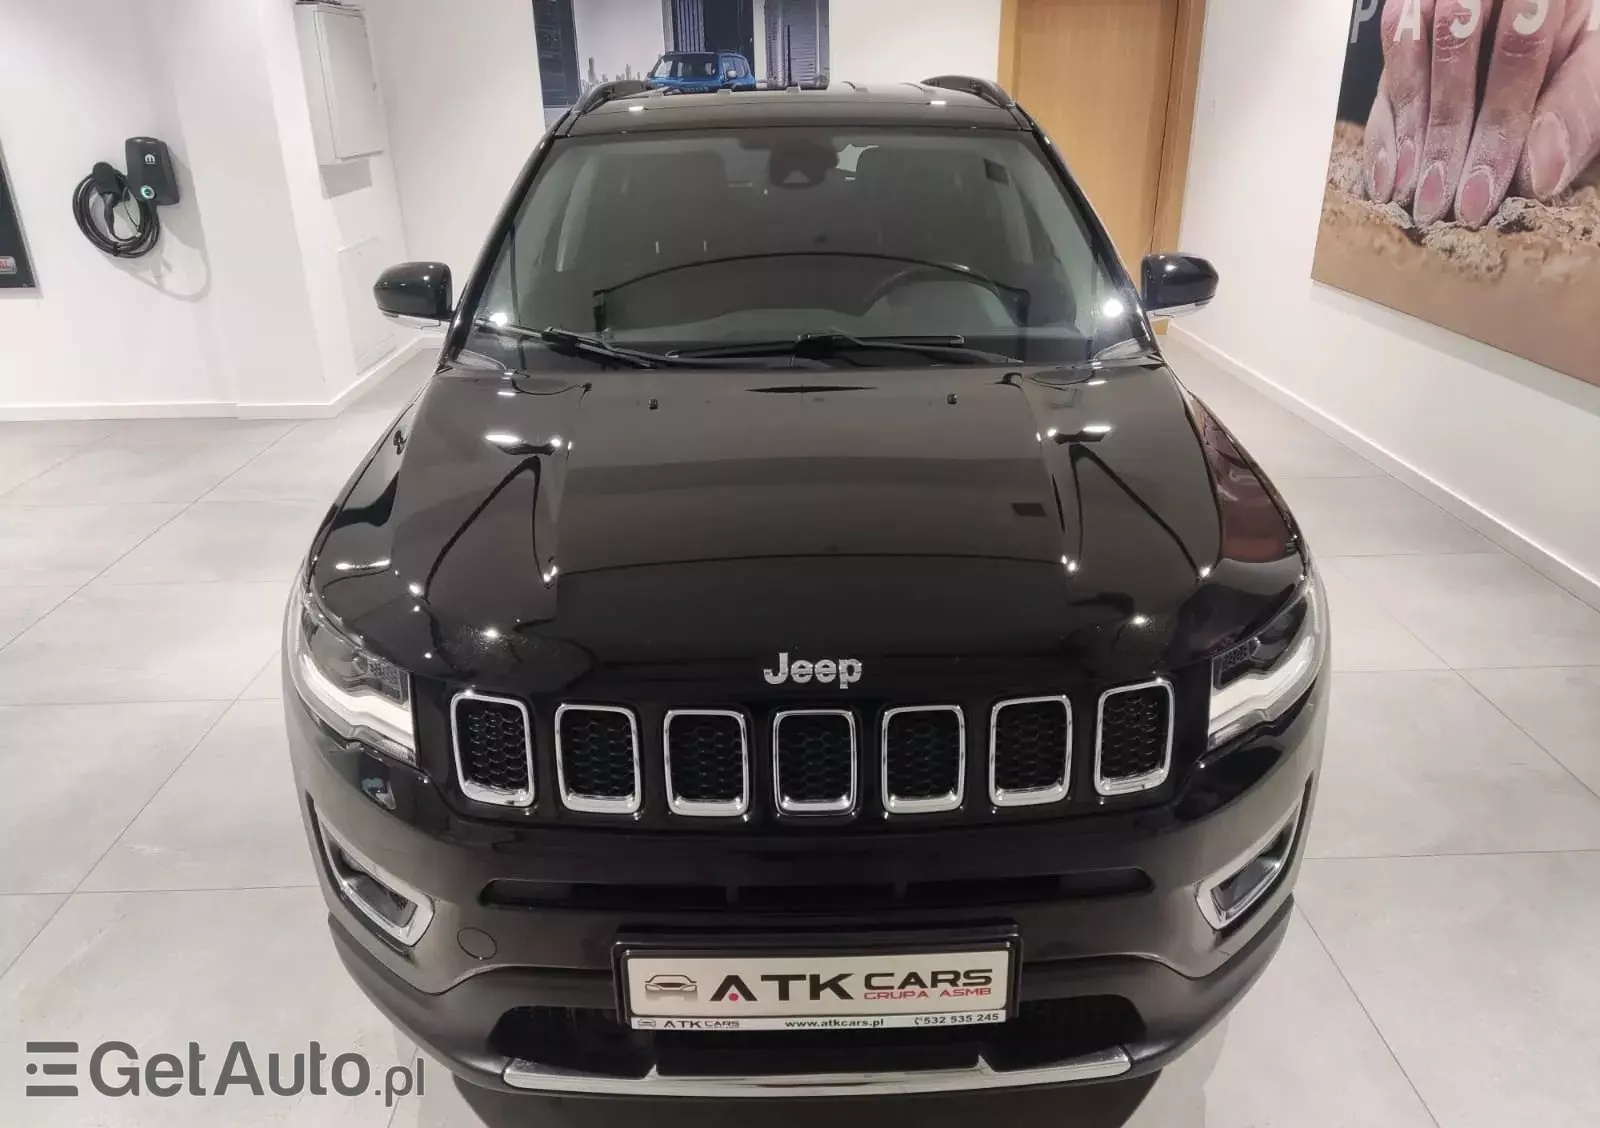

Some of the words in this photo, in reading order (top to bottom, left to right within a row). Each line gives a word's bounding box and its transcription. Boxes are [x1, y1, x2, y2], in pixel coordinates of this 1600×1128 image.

[763, 652, 863, 689] Jeep
[709, 972, 855, 1002] ATK
[863, 968, 993, 991] CARS
[863, 990, 929, 1001] GRUPA
[939, 987, 992, 998] ASMB
[663, 1020, 702, 1029] ATK
[704, 1020, 741, 1029] CARS
[784, 1018, 885, 1029] www.atkcars.pl
[923, 1015, 947, 1025] 532
[950, 1014, 973, 1024] 535
[976, 1012, 1000, 1022] 245
